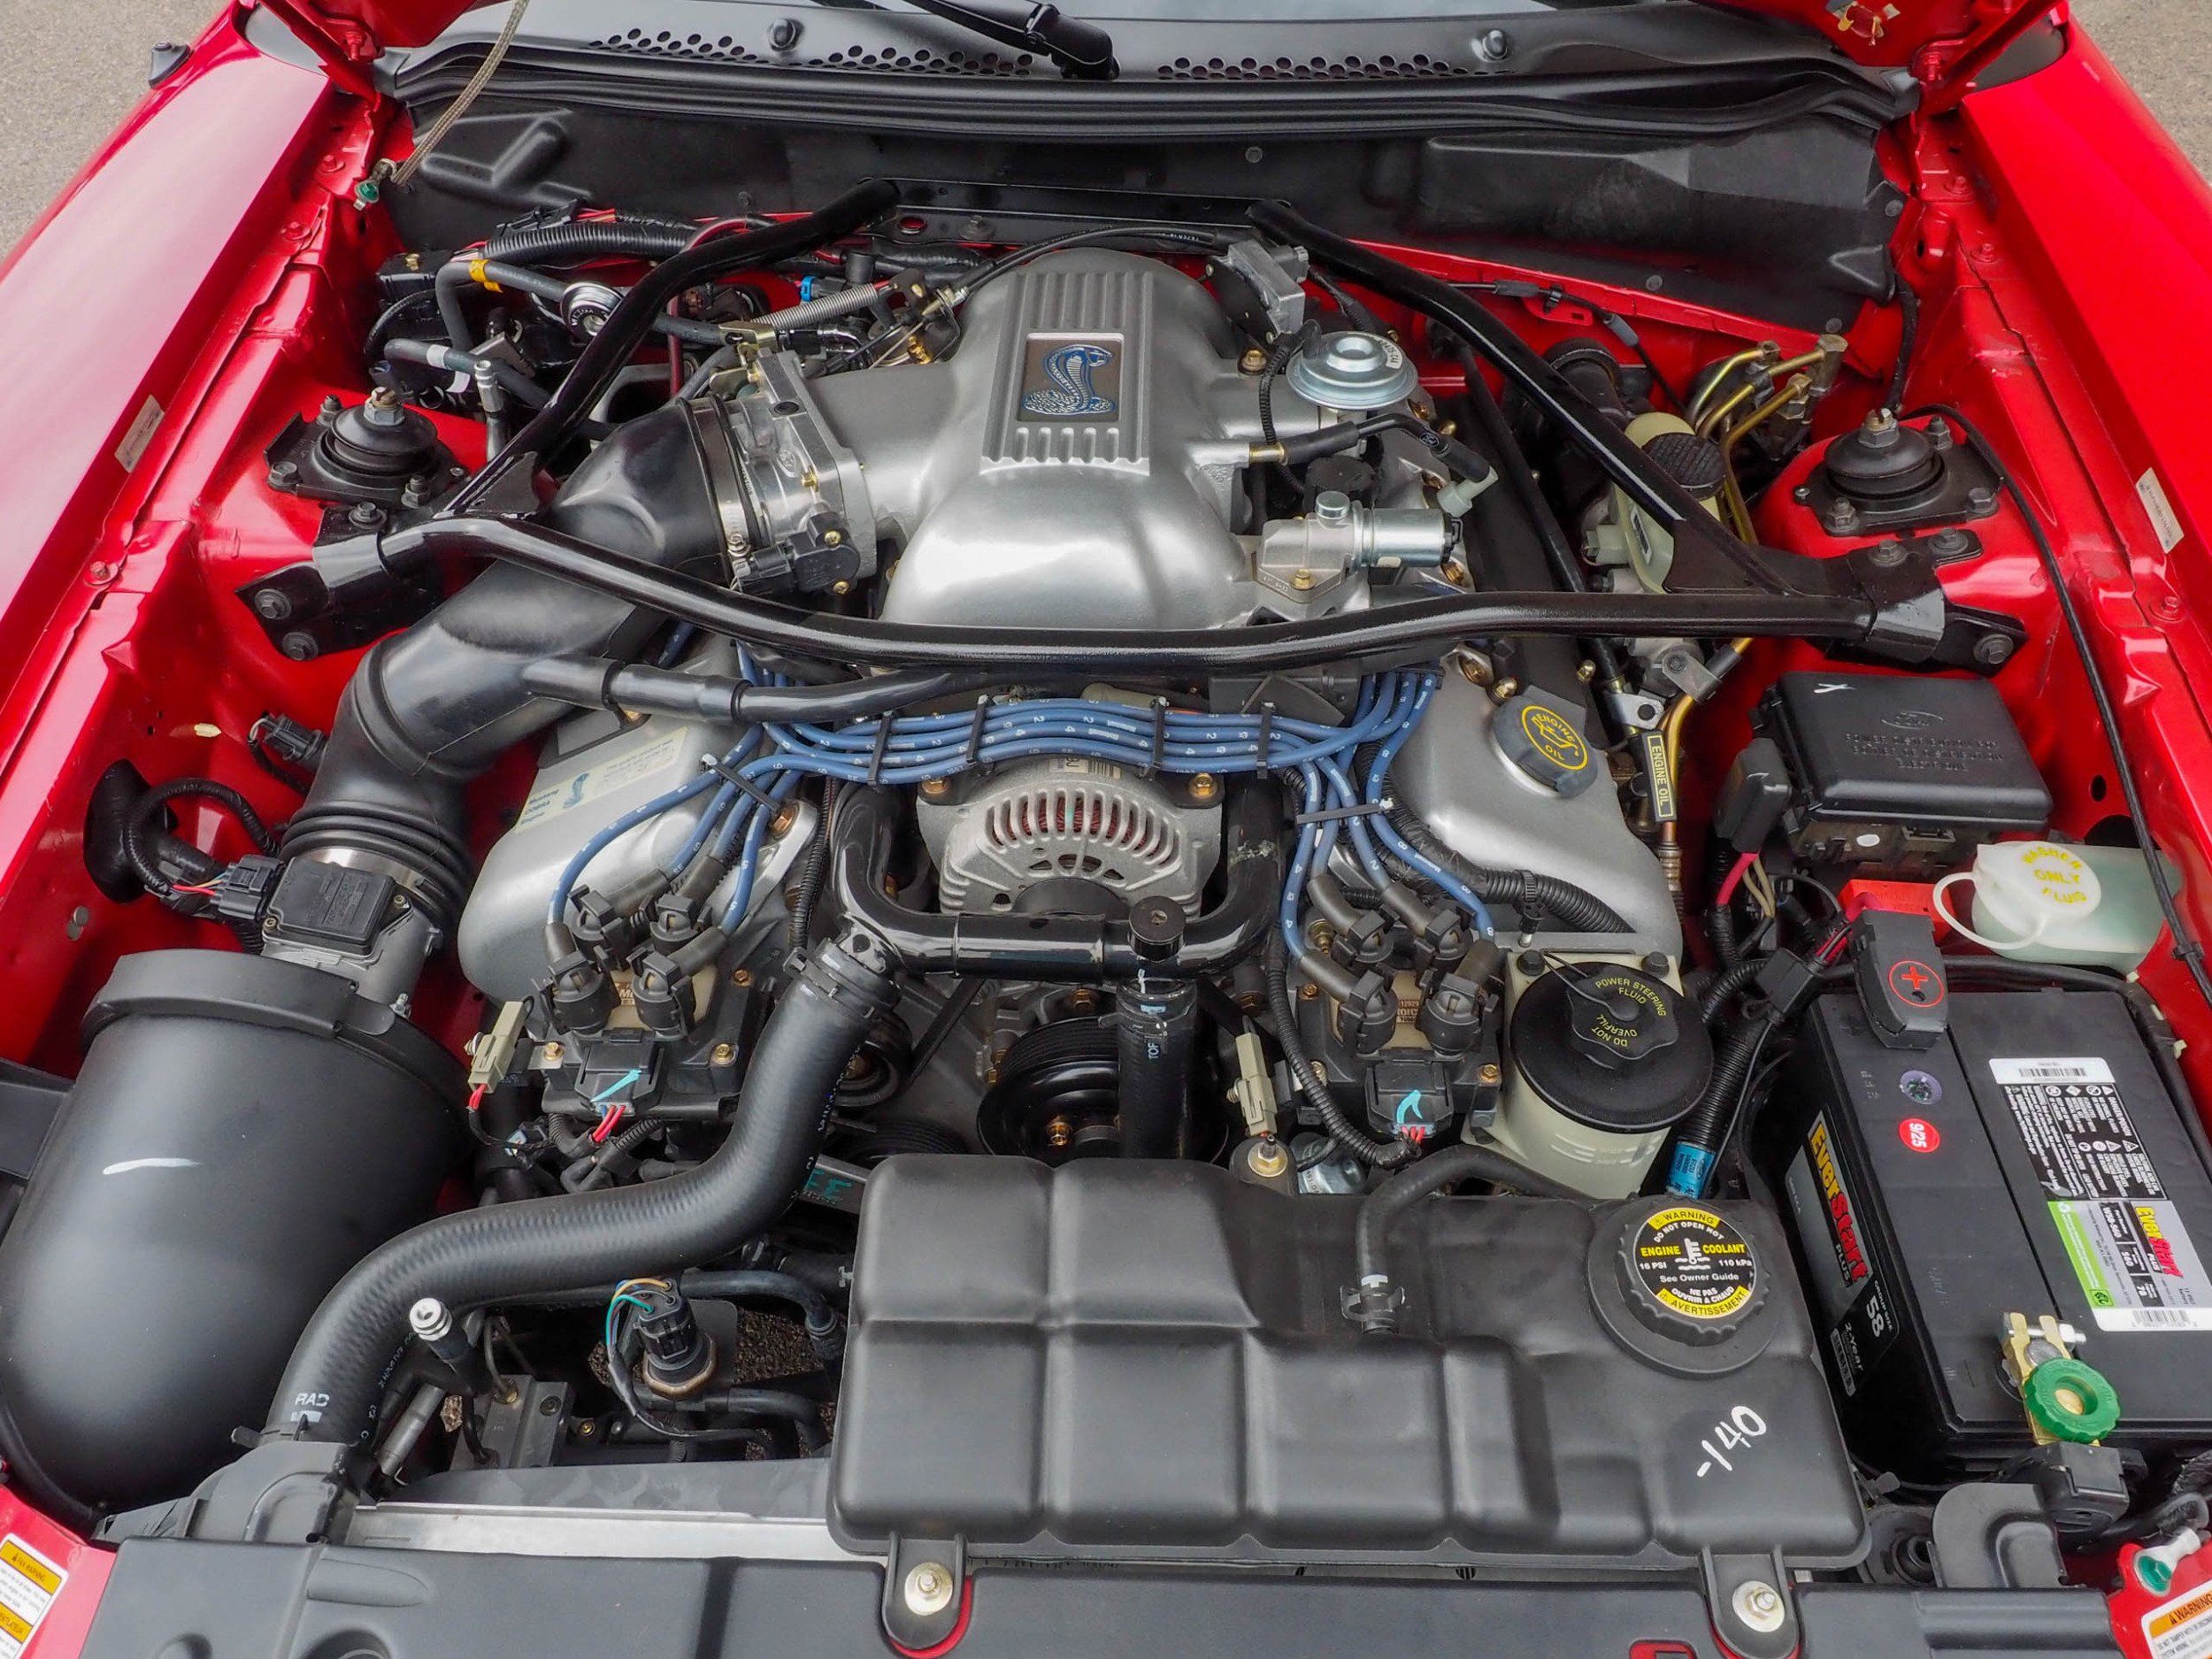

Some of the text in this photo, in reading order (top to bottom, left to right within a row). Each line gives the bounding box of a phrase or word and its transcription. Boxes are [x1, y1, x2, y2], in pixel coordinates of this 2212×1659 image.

[1536, 713, 1575, 744] ENGINE
[1545, 744, 1565, 760] OIL
[1651, 746, 1670, 806] ENGINE OIL
[1595, 978, 1666, 1017] POWER STEERING
[1618, 987, 1647, 1004] FLUID
[1592, 1027, 1628, 1047] DO NOT
[1596, 1014, 1638, 1037] OVERFILL
[1909, 1123, 1927, 1148] 9/25
[1810, 1122, 1869, 1282] EverStart
[1663, 1210, 1714, 1225] WARNING
[1654, 1233, 1664, 1243] DO
[1663, 1223, 1678, 1233] NOT
[1640, 1244, 1746, 1256] ENGINE COOLANT
[1835, 1243, 1851, 1283] PLUS
[2147, 1253, 2161, 1271] PLUS
[1671, 1287, 1703, 1304] OUVRIR
[1711, 1286, 1734, 1303] CHAUD
[1702, 1287, 1718, 1296] PAS
[1671, 1292, 1746, 1315] AVERTISSEMENT
[1866, 1295, 1885, 1338] 58
[295, 1392, 330, 1407] RAD
[1697, 1405, 1766, 1477] -140
[2174, 1594, 2212, 1620] WARNING
